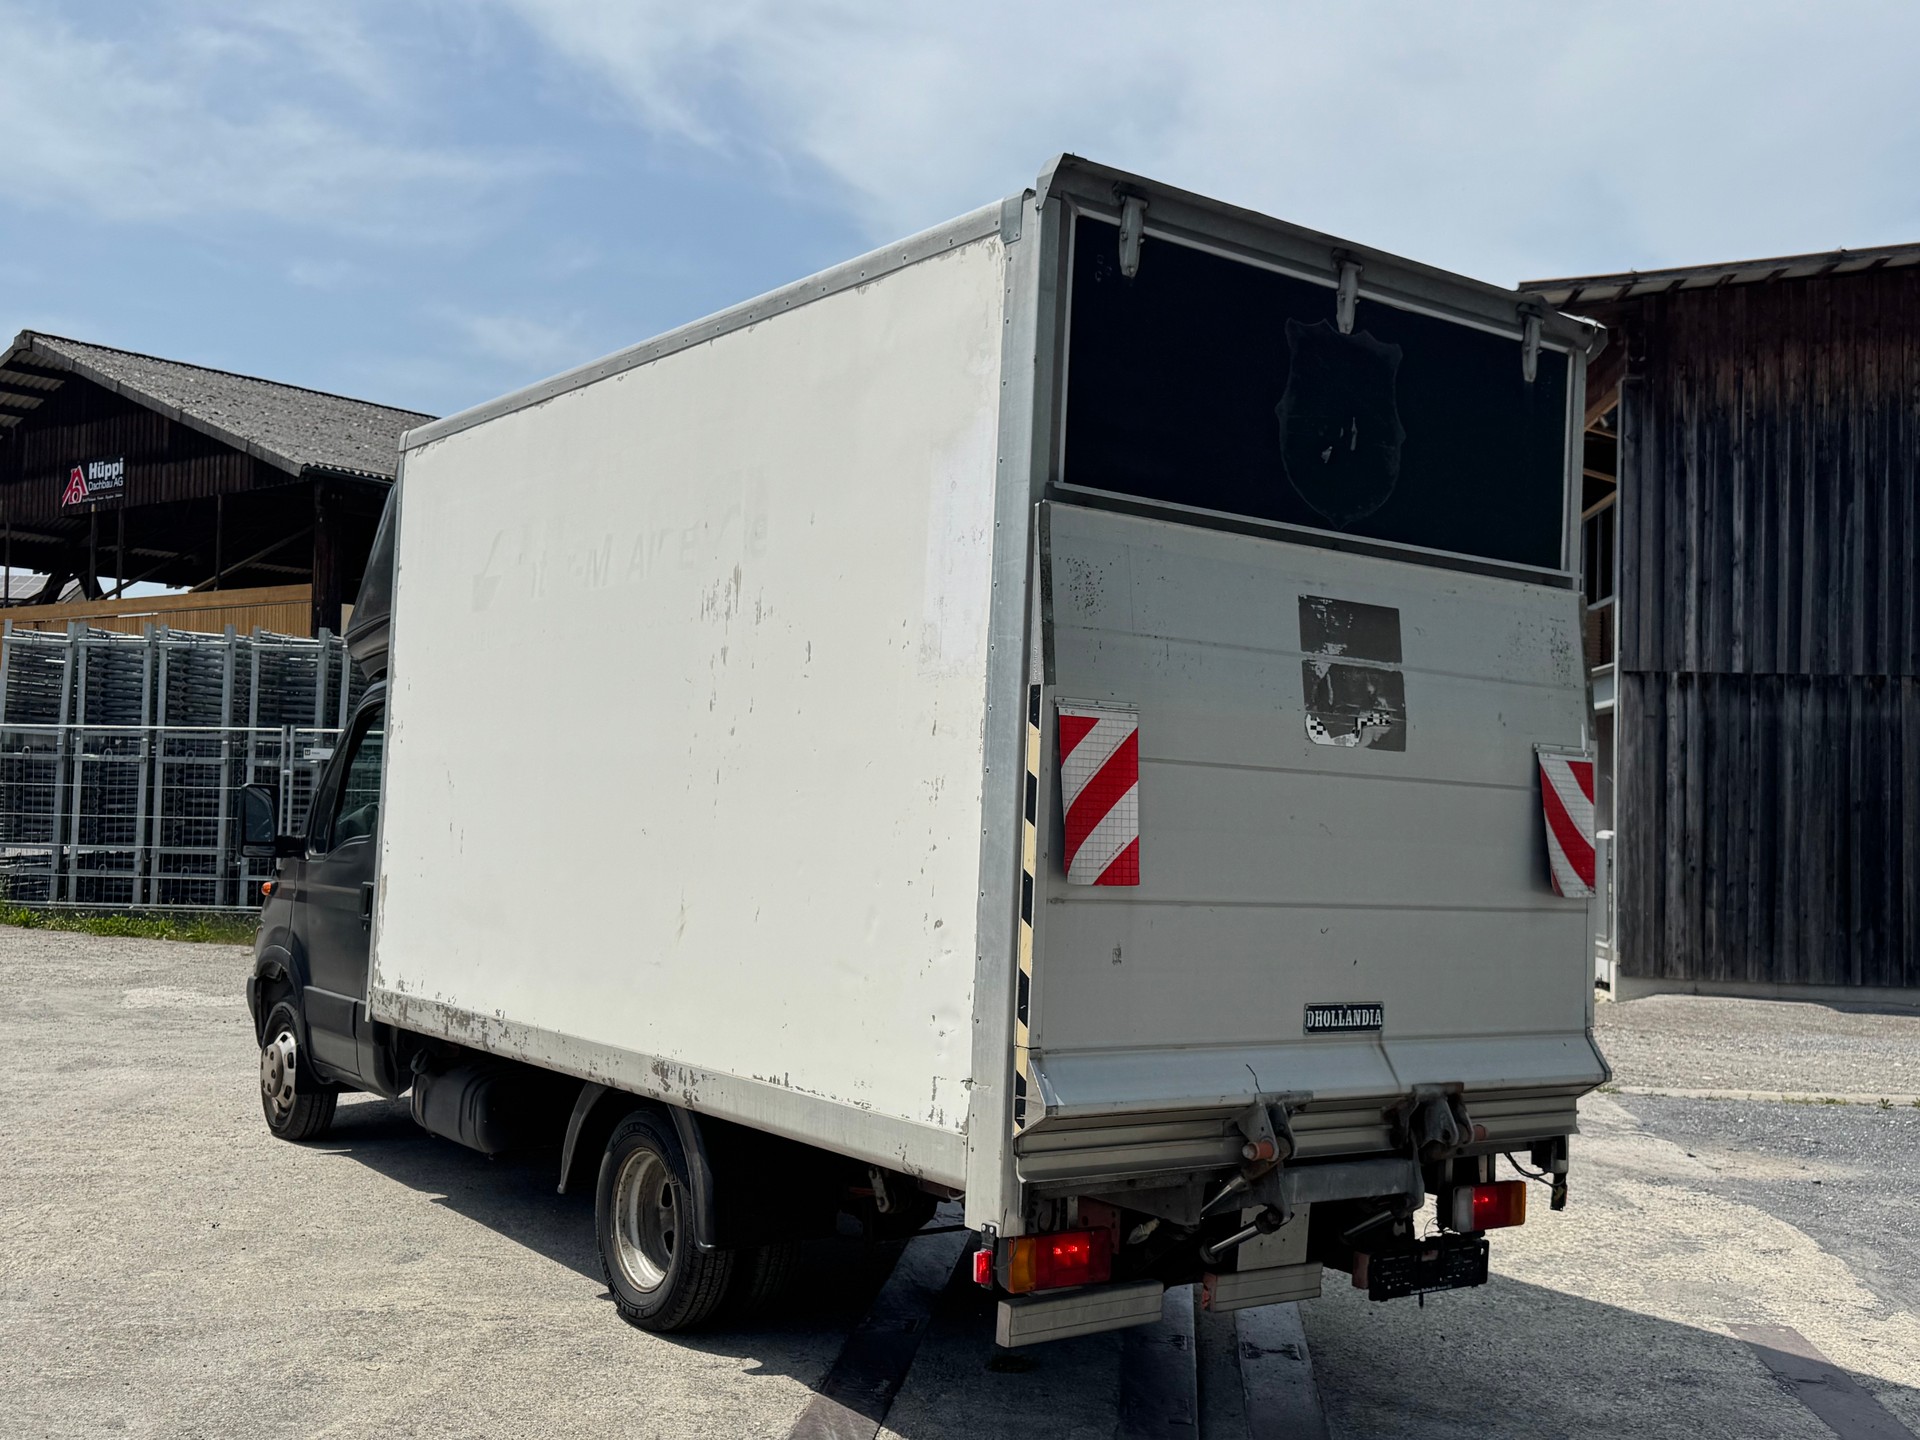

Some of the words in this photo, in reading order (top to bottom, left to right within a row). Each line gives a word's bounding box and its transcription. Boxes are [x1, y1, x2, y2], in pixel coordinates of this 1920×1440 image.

[88, 457, 124, 480] Hüppi
[88, 479, 113, 491] Dachbau
[113, 477, 124, 487] AG
[1306, 1009, 1382, 1028] DHOLLANDIA
